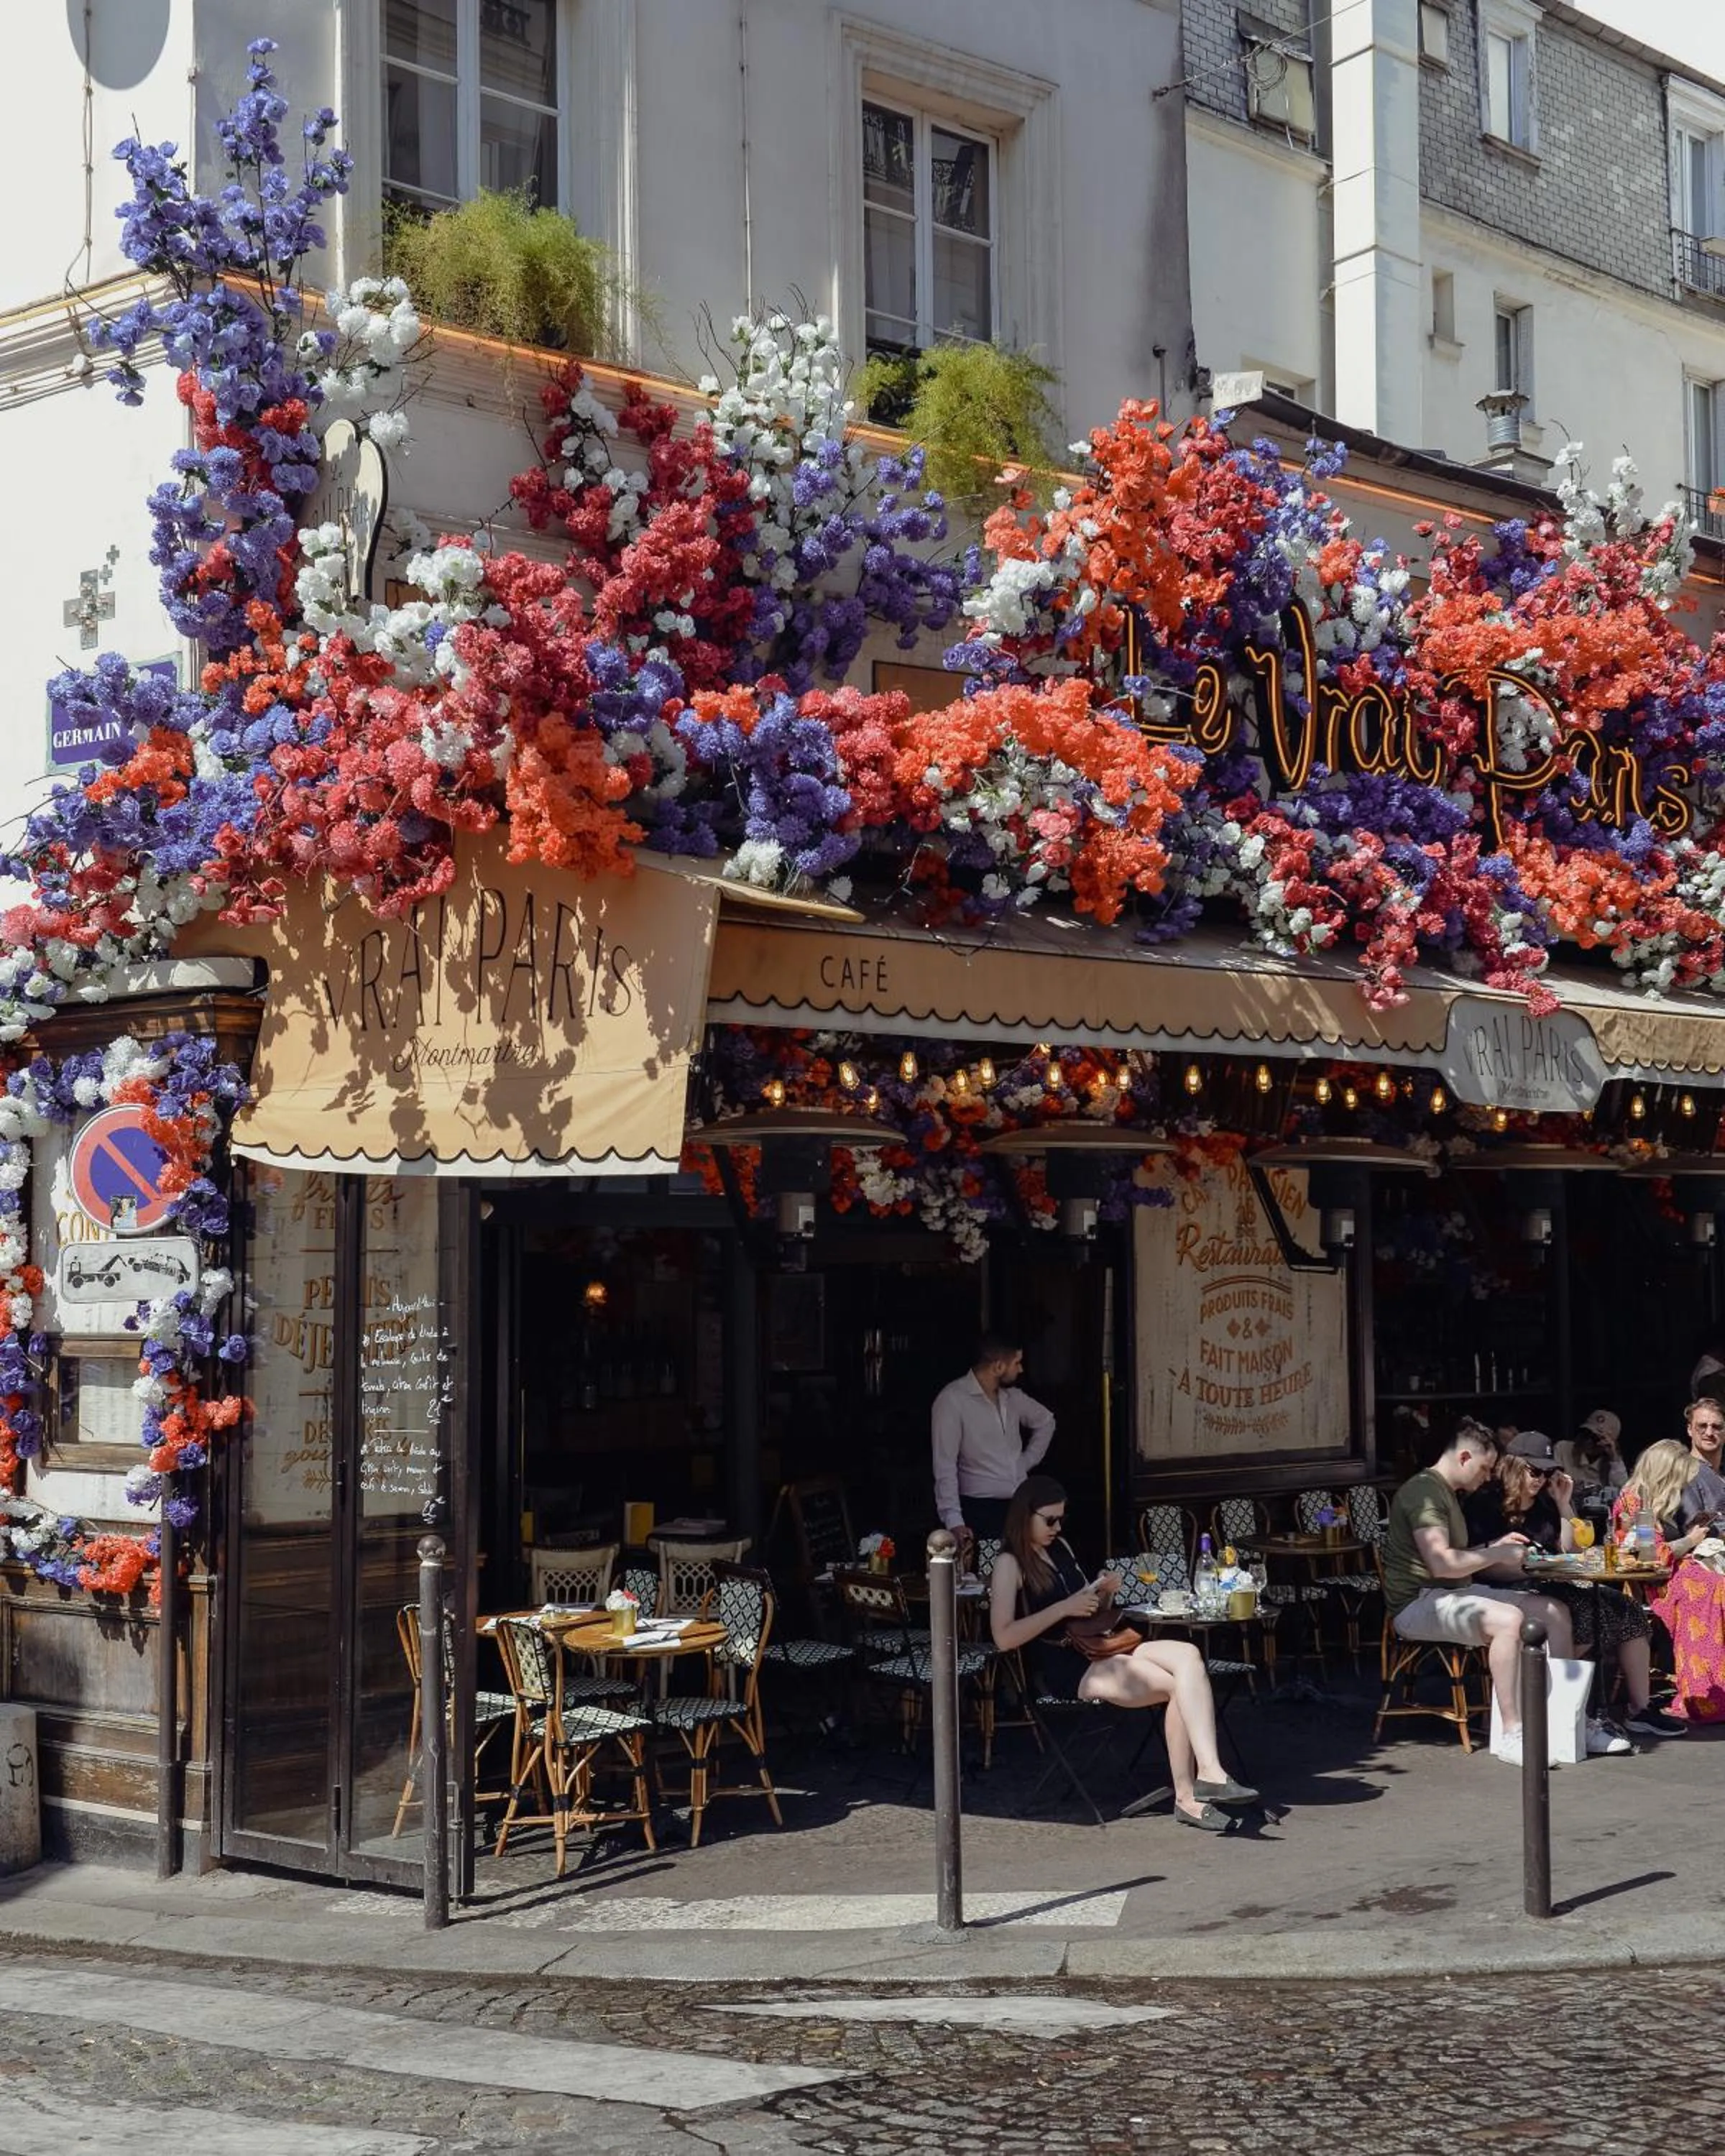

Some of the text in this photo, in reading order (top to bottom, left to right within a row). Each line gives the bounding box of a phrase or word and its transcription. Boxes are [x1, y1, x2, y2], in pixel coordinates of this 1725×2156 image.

[1125, 606, 1233, 755] Le
[1244, 601, 1443, 791] Vrai
[52, 721, 121, 749] GERMAIN
[323, 888, 633, 1031] VRAI PARIS
[819, 955, 888, 992] CAFÉ
[392, 1036, 539, 1073] Montmartre
[1463, 1014, 1584, 1083] VRAI PARIS
[1200, 1289, 1294, 1325] PRODUITS FRAIS
[1242, 1317, 1253, 1340] &
[1200, 1335, 1293, 1374] FAIT MAISON
[1196, 1375, 1255, 1408] TOUTE
[1259, 1361, 1313, 1406] HEURE
